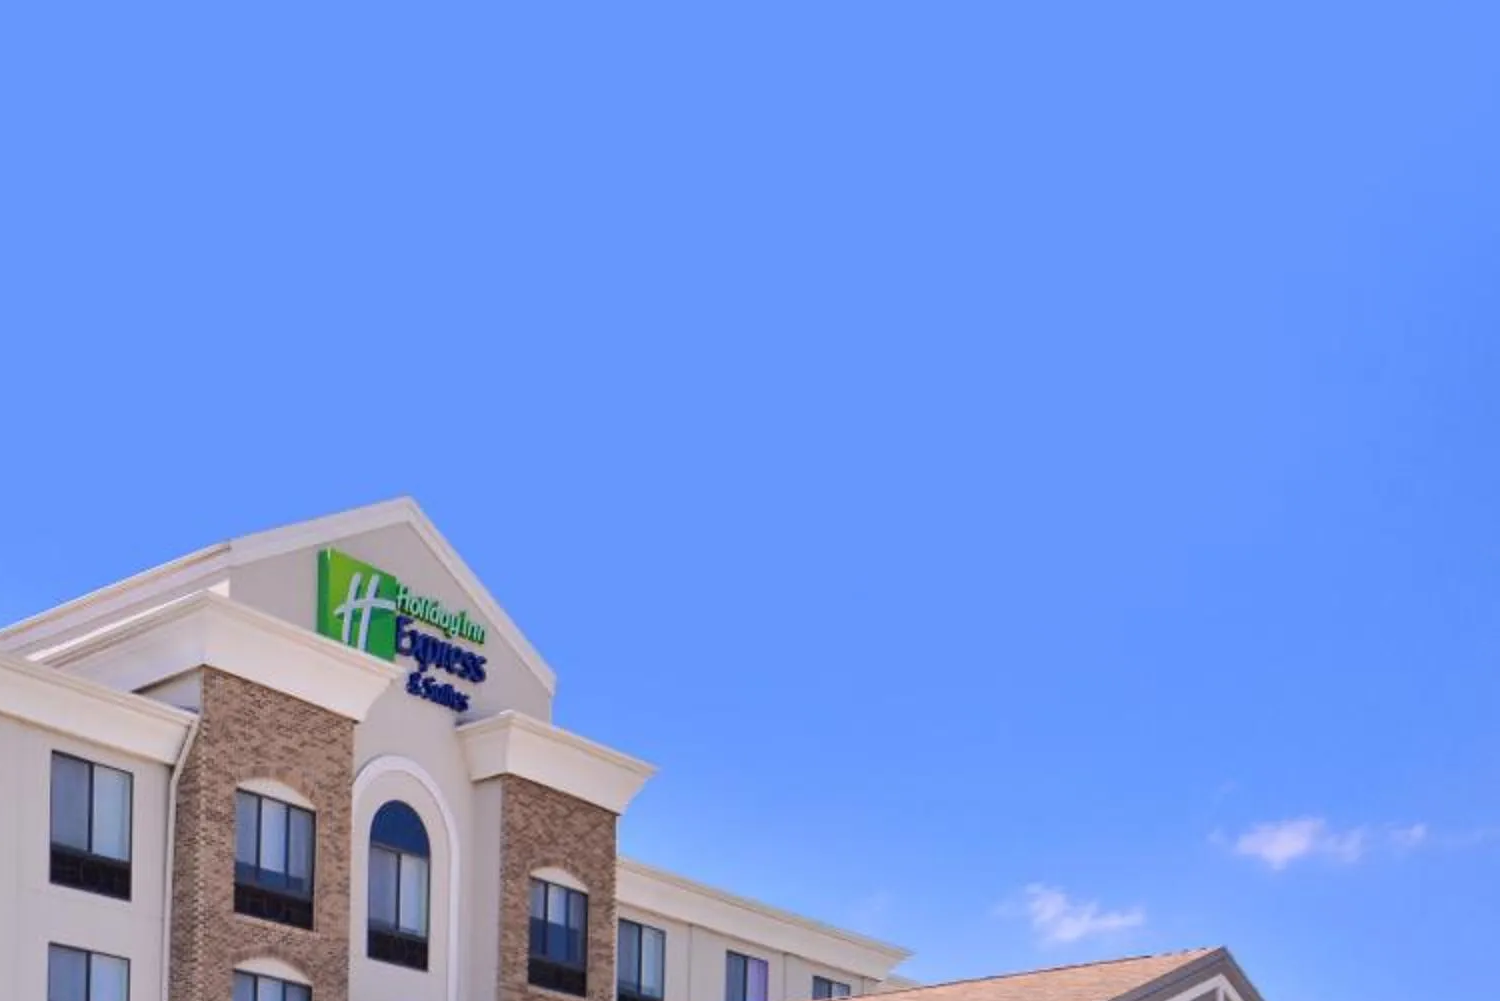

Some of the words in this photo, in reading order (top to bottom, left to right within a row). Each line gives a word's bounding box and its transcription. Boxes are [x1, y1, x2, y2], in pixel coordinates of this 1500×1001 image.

[396, 584, 460, 638] Holiday
[459, 611, 485, 644] Inn
[396, 615, 487, 683] Express
[421, 676, 470, 712] Suites
